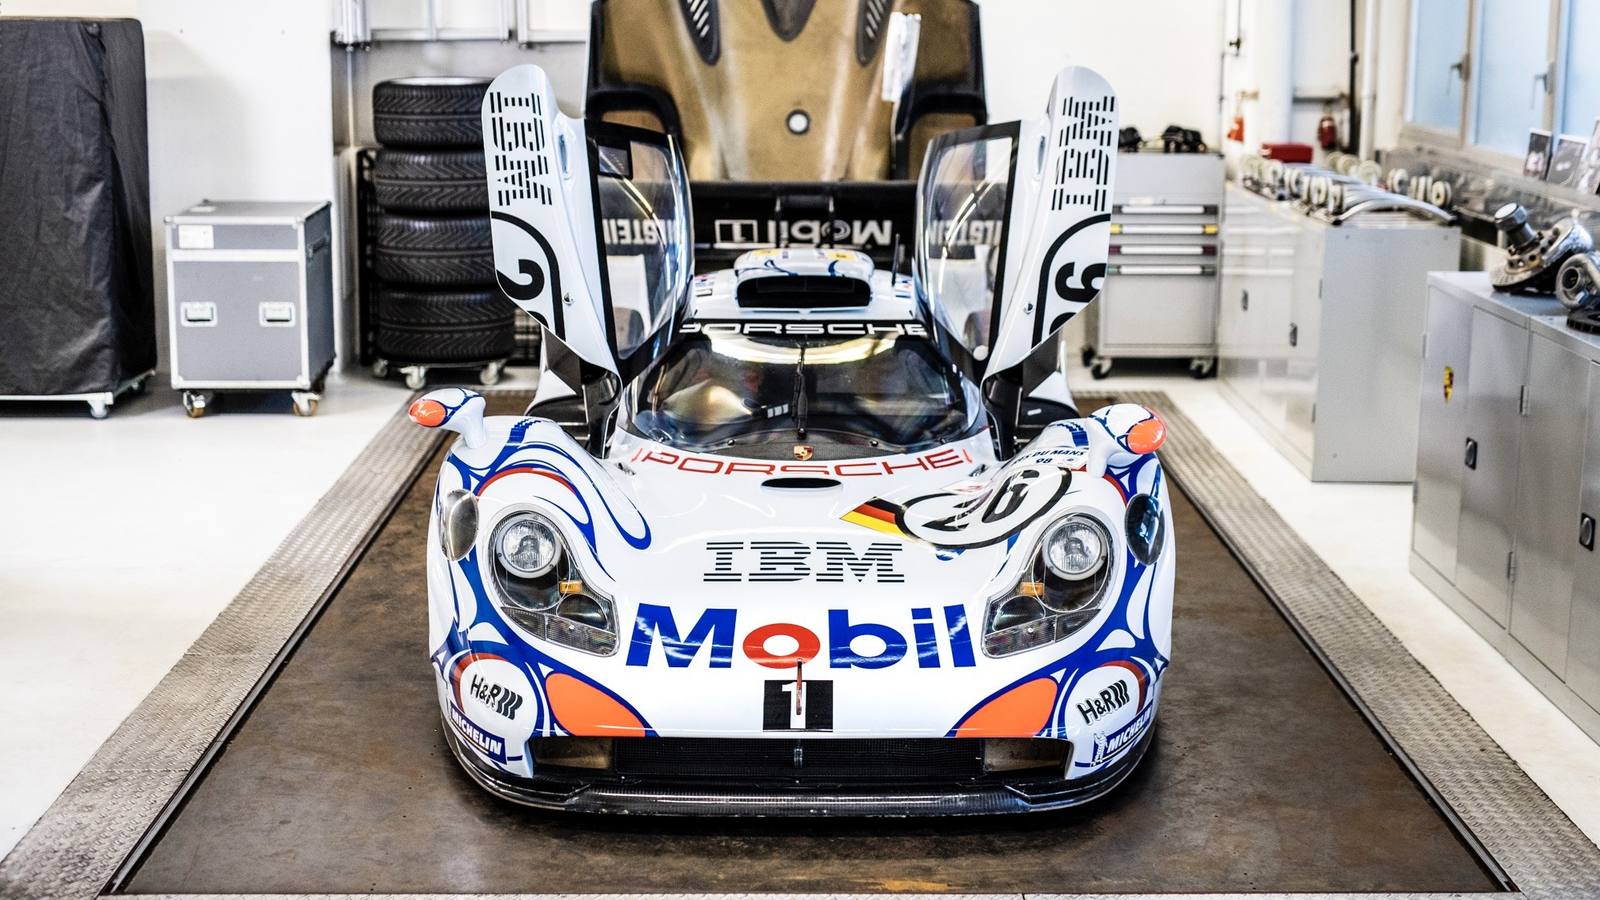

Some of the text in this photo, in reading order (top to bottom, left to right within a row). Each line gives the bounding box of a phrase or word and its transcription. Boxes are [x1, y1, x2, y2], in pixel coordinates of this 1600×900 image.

[489, 91, 553, 206] IBM
[1051, 96, 1116, 212] IBM
[767, 219, 892, 246] Mobil
[496, 259, 549, 329] 2
[679, 323, 928, 336] PORSCHE
[641, 448, 965, 477] PORSCHE
[703, 541, 905, 583] IBM
[625, 603, 977, 670] Mobil
[781, 681, 808, 729] 1
[1076, 686, 1119, 725] H&R
[451, 707, 502, 755] MICHELIN
